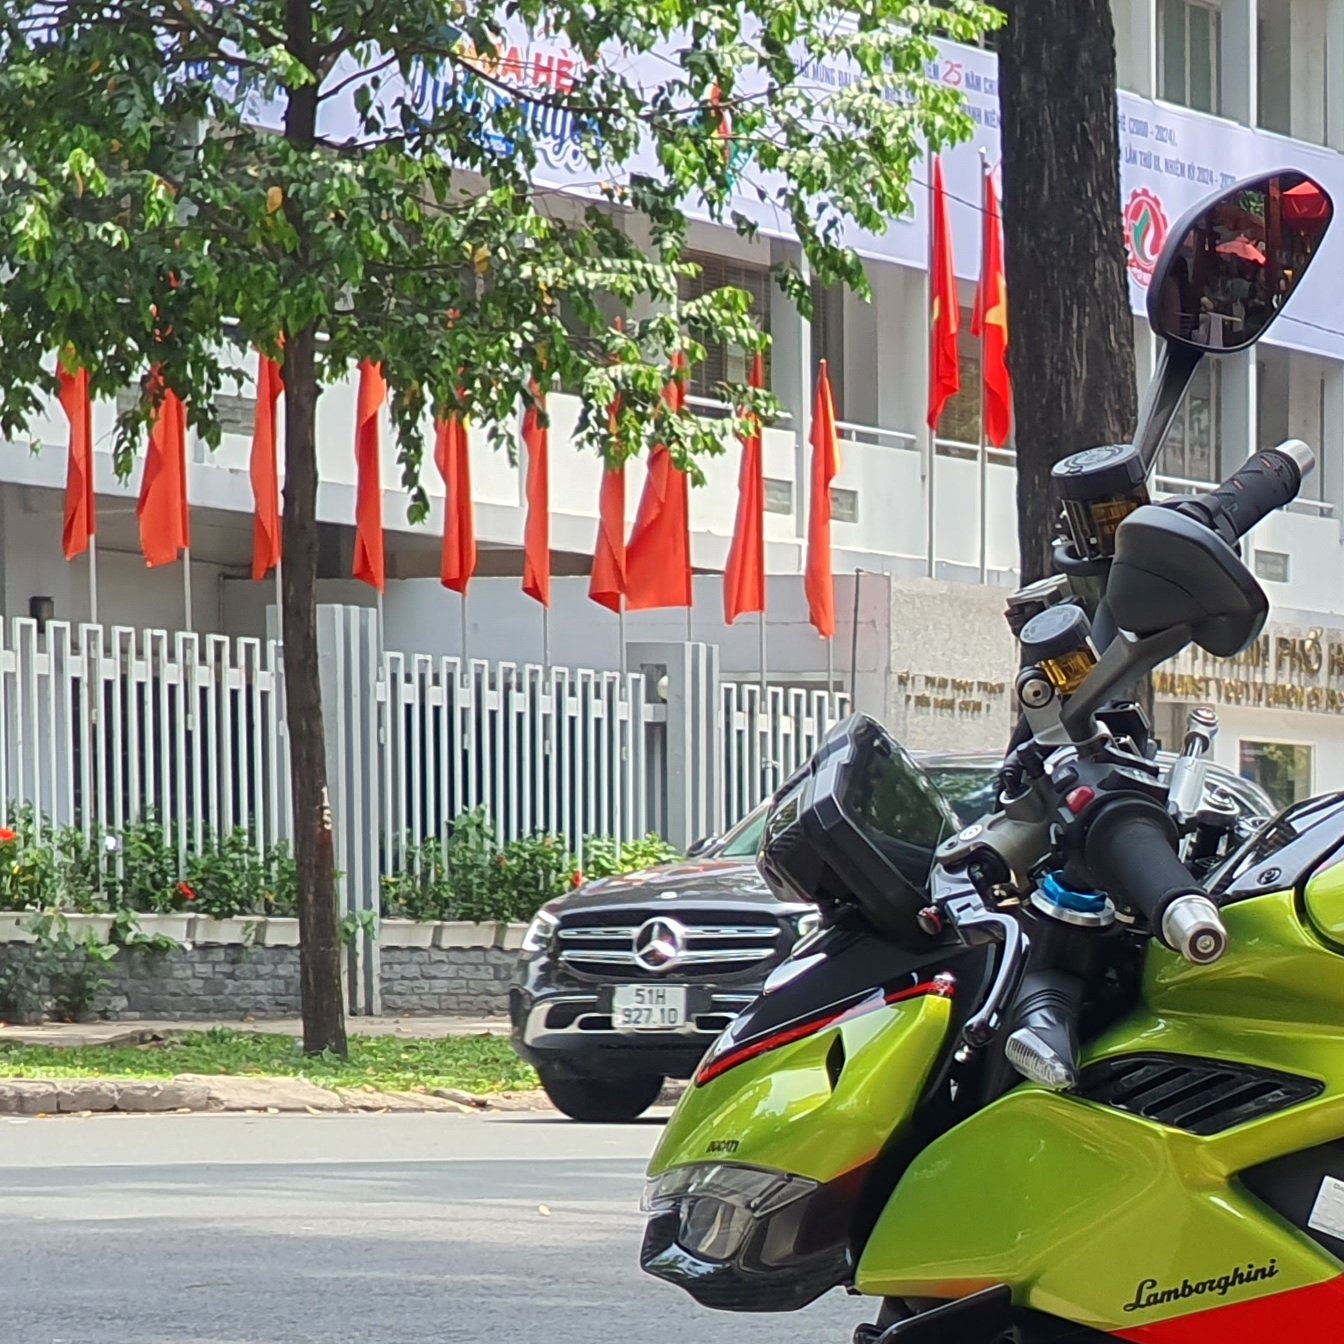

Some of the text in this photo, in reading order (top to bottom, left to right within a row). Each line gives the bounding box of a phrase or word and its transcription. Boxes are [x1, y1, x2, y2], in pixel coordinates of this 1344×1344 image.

[942, 60, 962, 86] 25
[634, 988, 666, 1005] 51H
[622, 1007, 679, 1025] 927.10
[1123, 1259, 1279, 1312] Lamborghini
